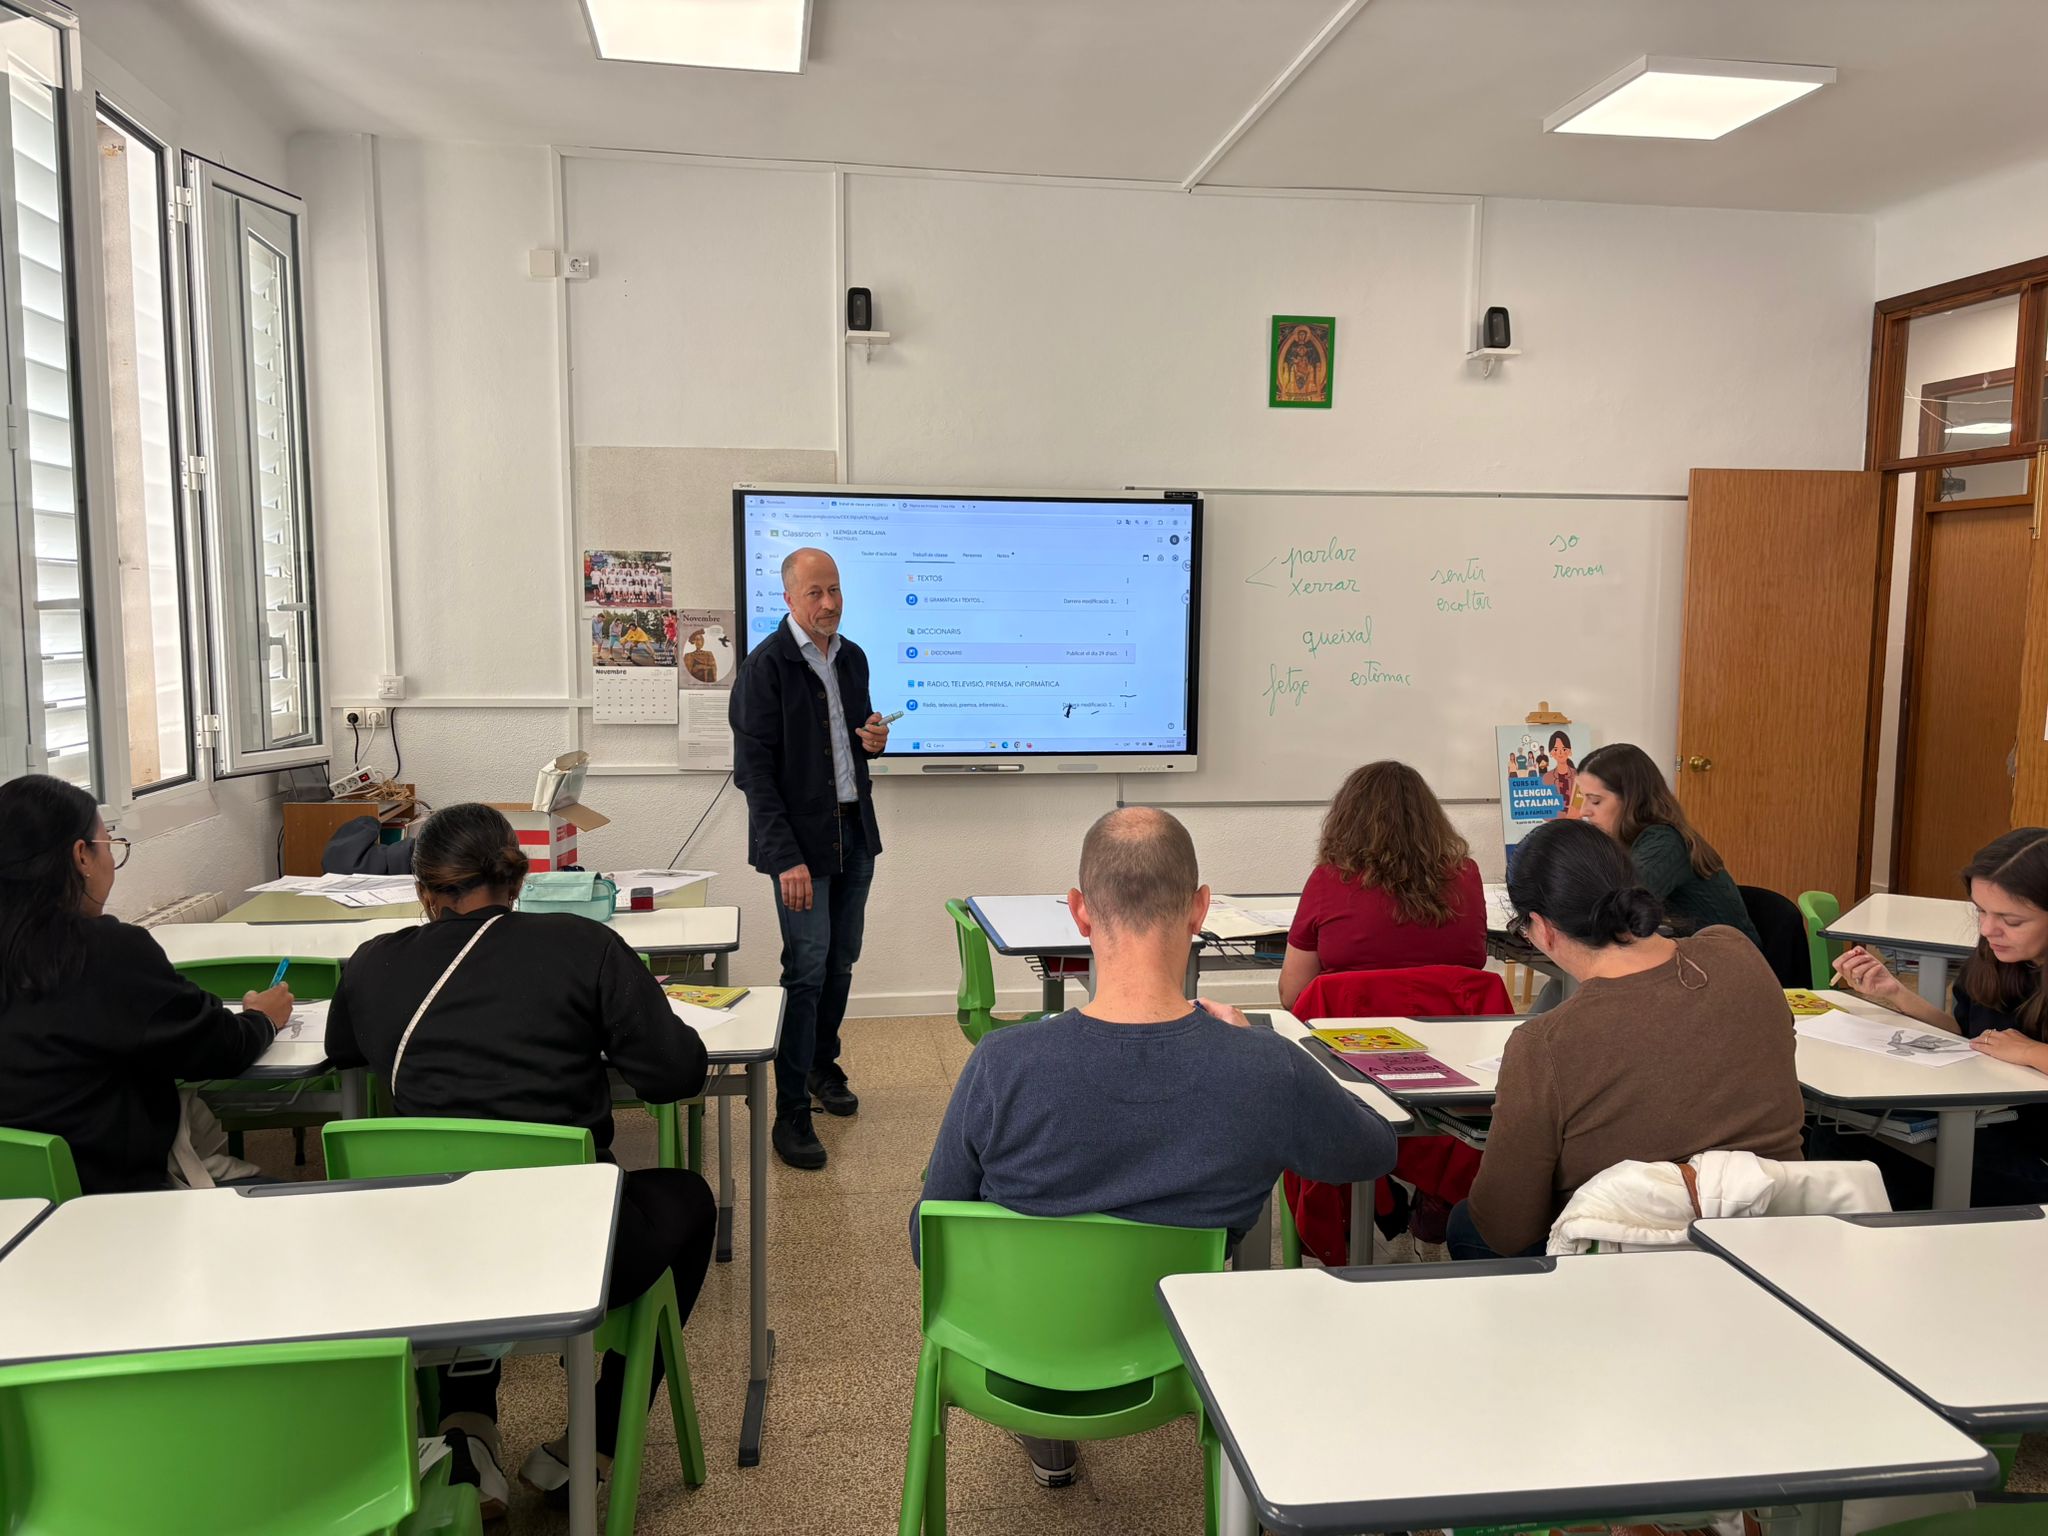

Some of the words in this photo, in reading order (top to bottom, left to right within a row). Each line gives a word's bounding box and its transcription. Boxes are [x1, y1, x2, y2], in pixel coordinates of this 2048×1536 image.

[782, 529, 821, 538] Classroom
[1281, 536, 1356, 578] parlar
[1430, 557, 1485, 584] sentir
[1552, 564, 1604, 578] renou
[1288, 578, 1360, 597] xerrar
[1437, 589, 1492, 612] escoltar
[683, 613, 720, 623] Novembre
[917, 627, 961, 635] DICCIONARIS
[1302, 615, 1372, 659] queixal
[1262, 663, 1310, 717] fetge
[1513, 789, 1552, 797] LLENGUA
[1514, 798, 1560, 808] CATALANA
